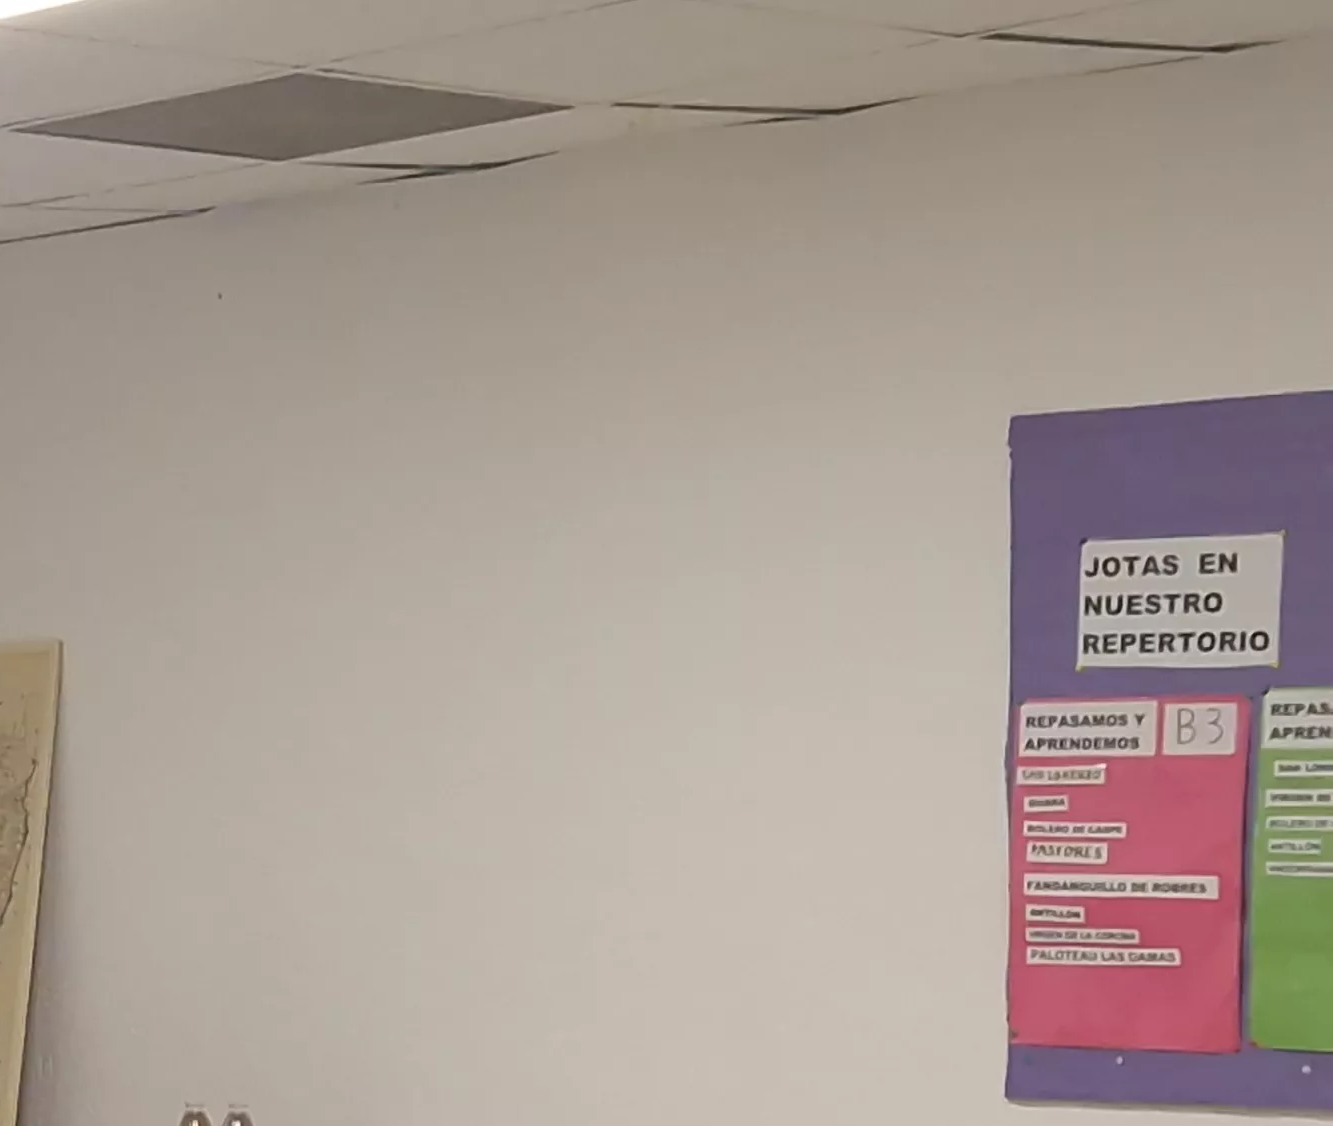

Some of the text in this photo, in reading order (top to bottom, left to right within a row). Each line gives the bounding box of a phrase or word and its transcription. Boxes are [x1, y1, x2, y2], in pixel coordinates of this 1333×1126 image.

[1084, 552, 1238, 578] JOTAS EN
[1083, 592, 1223, 616] NUESTRO
[1082, 630, 1270, 655] REPERTORIO
[1270, 702, 1333, 716] REPAS
[1025, 714, 1146, 728] REPASAMOS Y
[1024, 737, 1140, 751] APRENDEMOS
[1031, 844, 1103, 859] PASTORES
